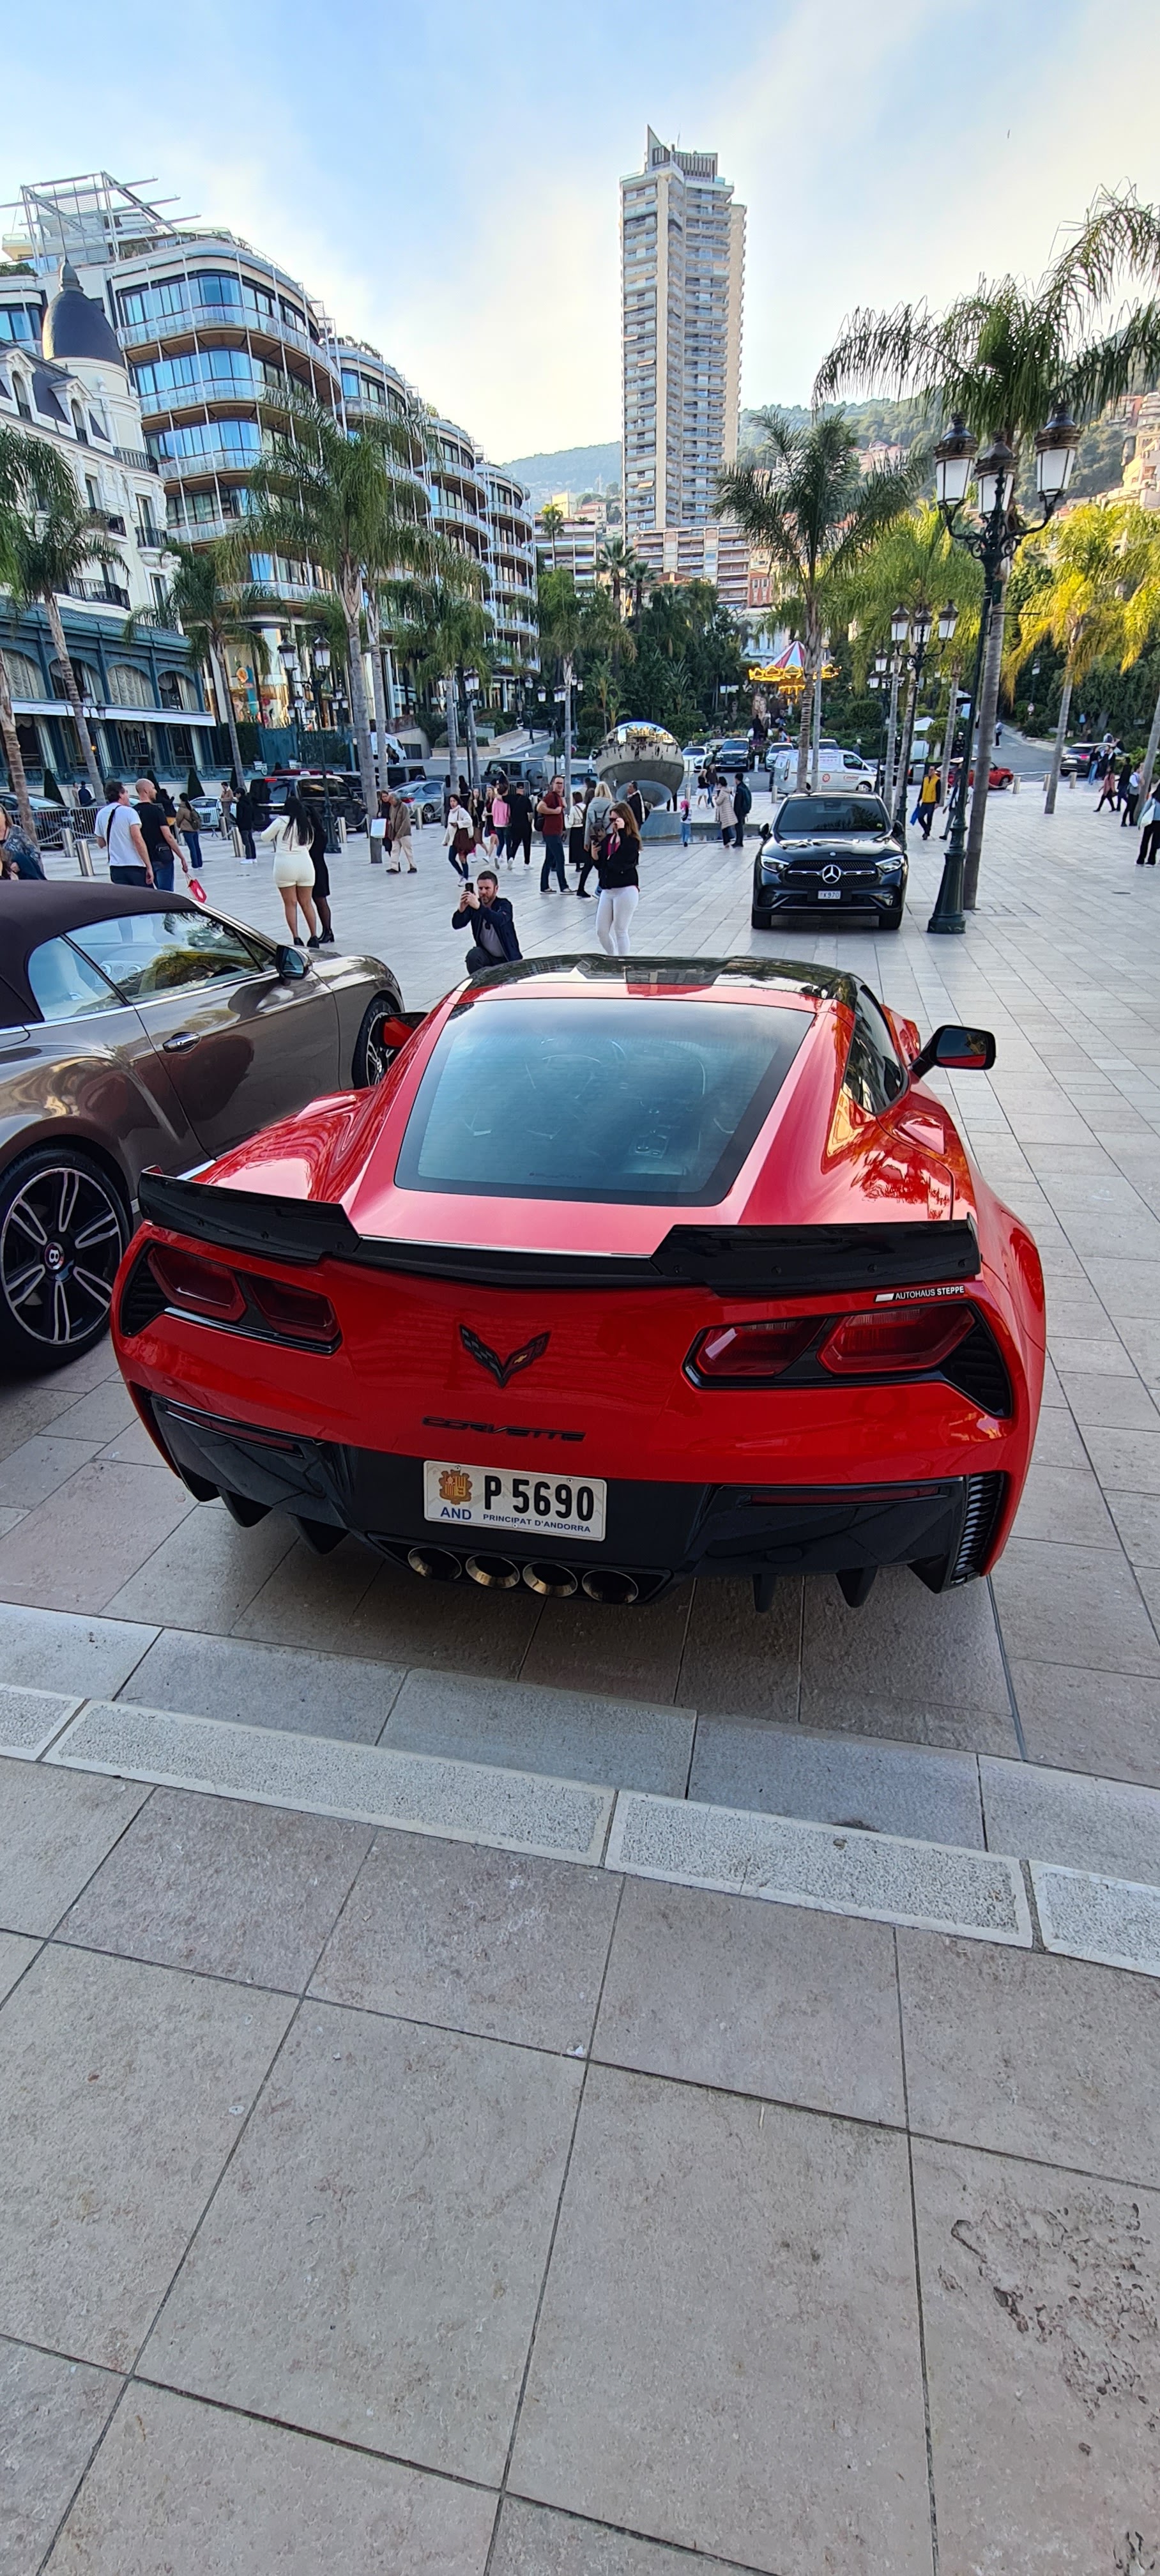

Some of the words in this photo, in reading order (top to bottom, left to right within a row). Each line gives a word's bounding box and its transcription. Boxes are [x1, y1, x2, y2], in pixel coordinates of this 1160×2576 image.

[895, 1289, 935, 1300] AUTOHAUS
[936, 1285, 965, 1296] STEPPE
[422, 1416, 586, 1442] CORVETTE
[484, 1475, 501, 1510] P
[512, 1478, 594, 1521] 5690
[440, 1506, 472, 1521] AND
[483, 1514, 532, 1526] PRINCIPAT
[535, 1520, 591, 1533] D'ANDORRA
